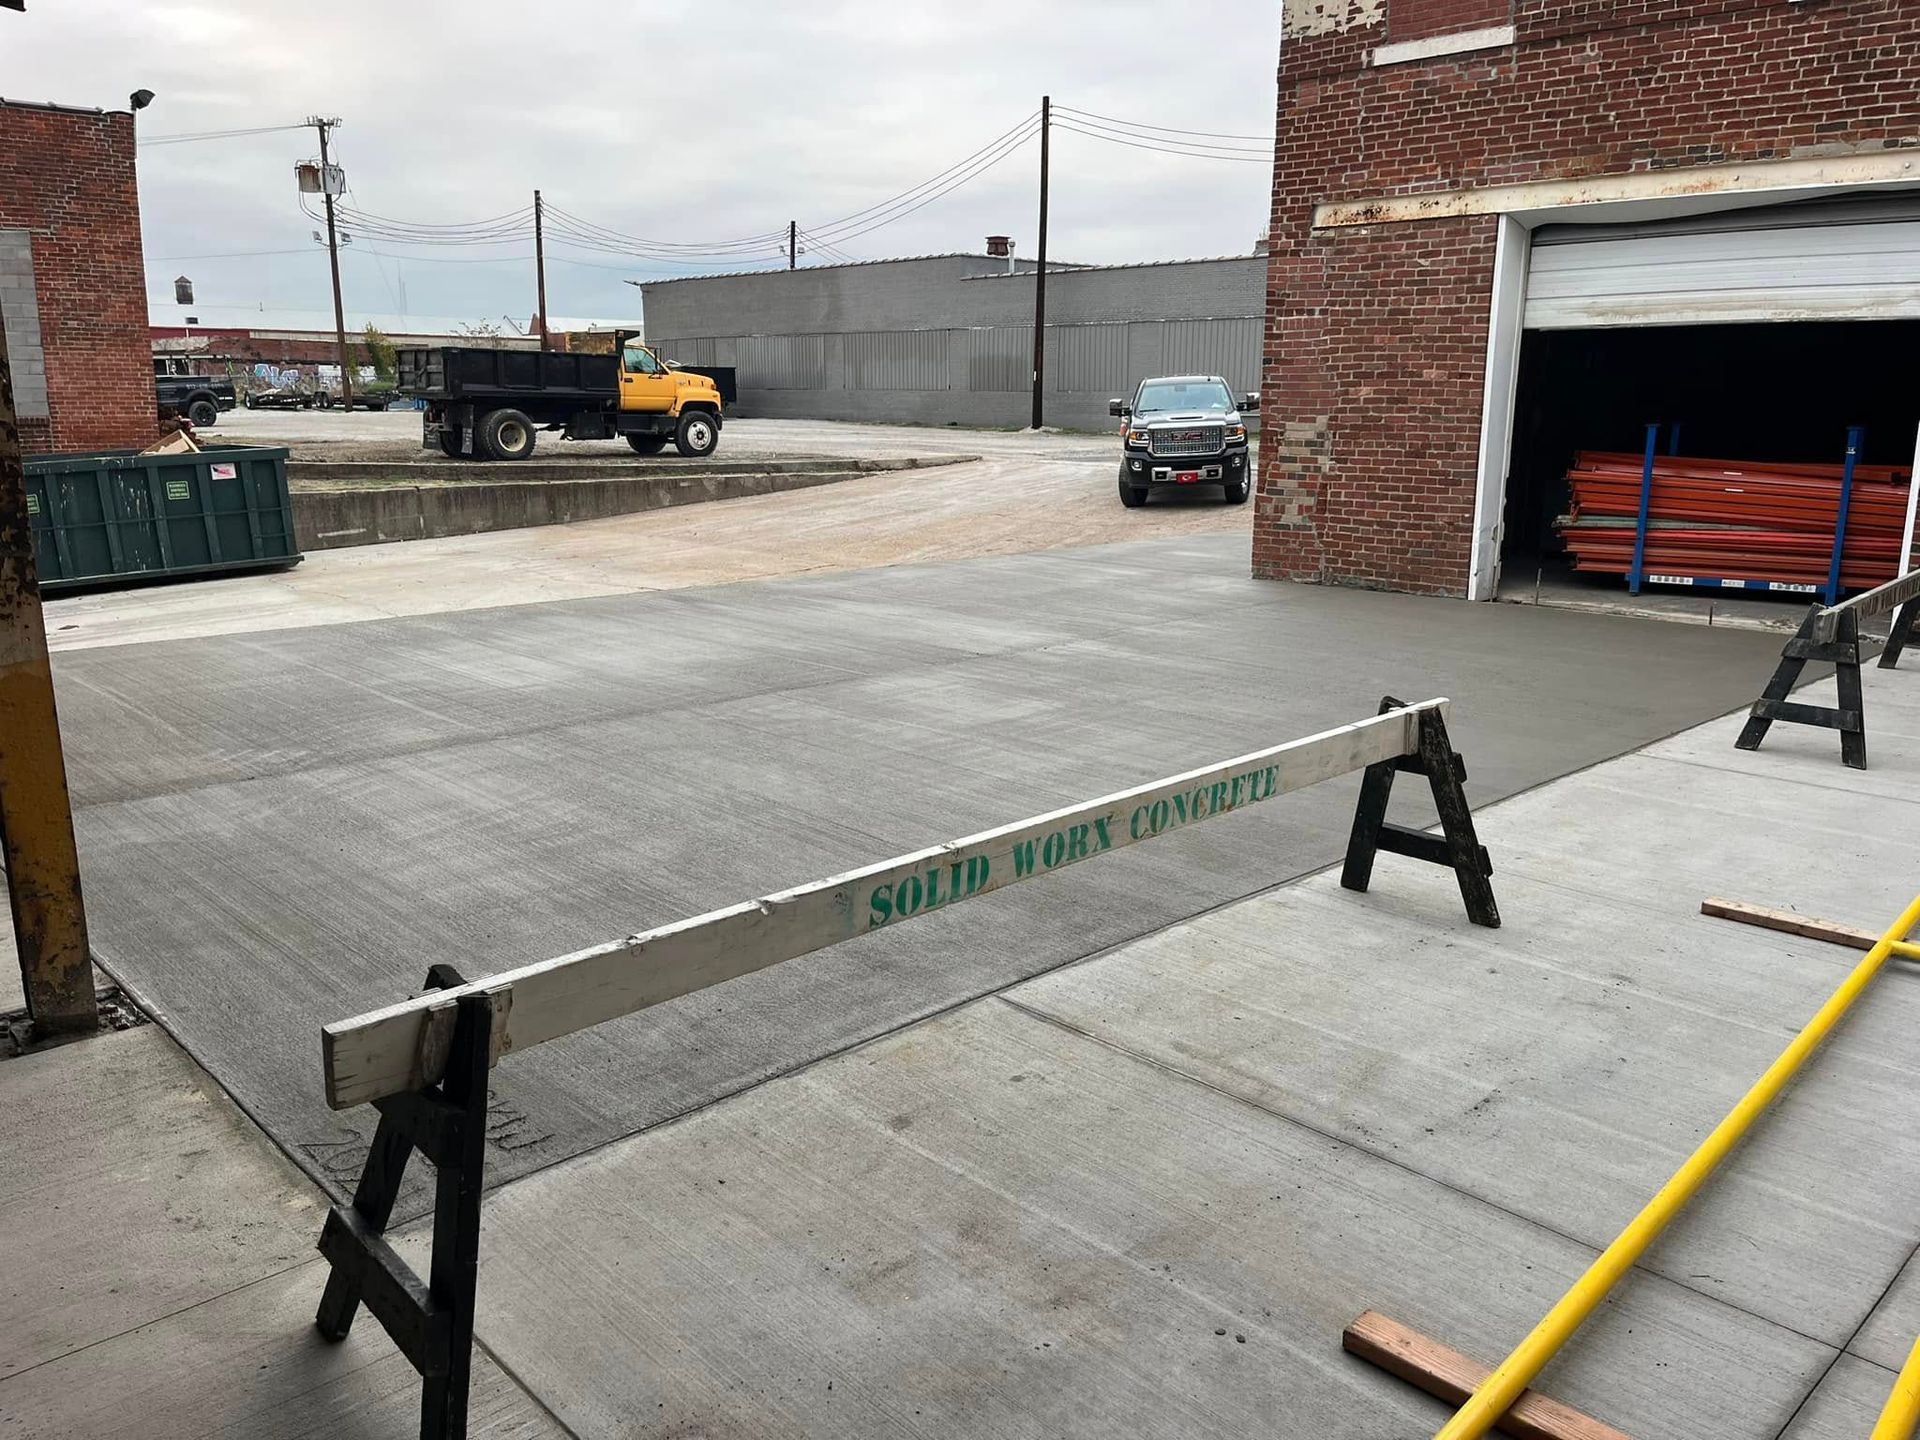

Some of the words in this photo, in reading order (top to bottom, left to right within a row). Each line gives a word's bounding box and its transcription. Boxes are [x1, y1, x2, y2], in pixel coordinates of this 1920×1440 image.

[869, 855, 990, 929] SOLID
[1012, 815, 1114, 878] WORX
[1130, 765, 1279, 840] CONCRETE
